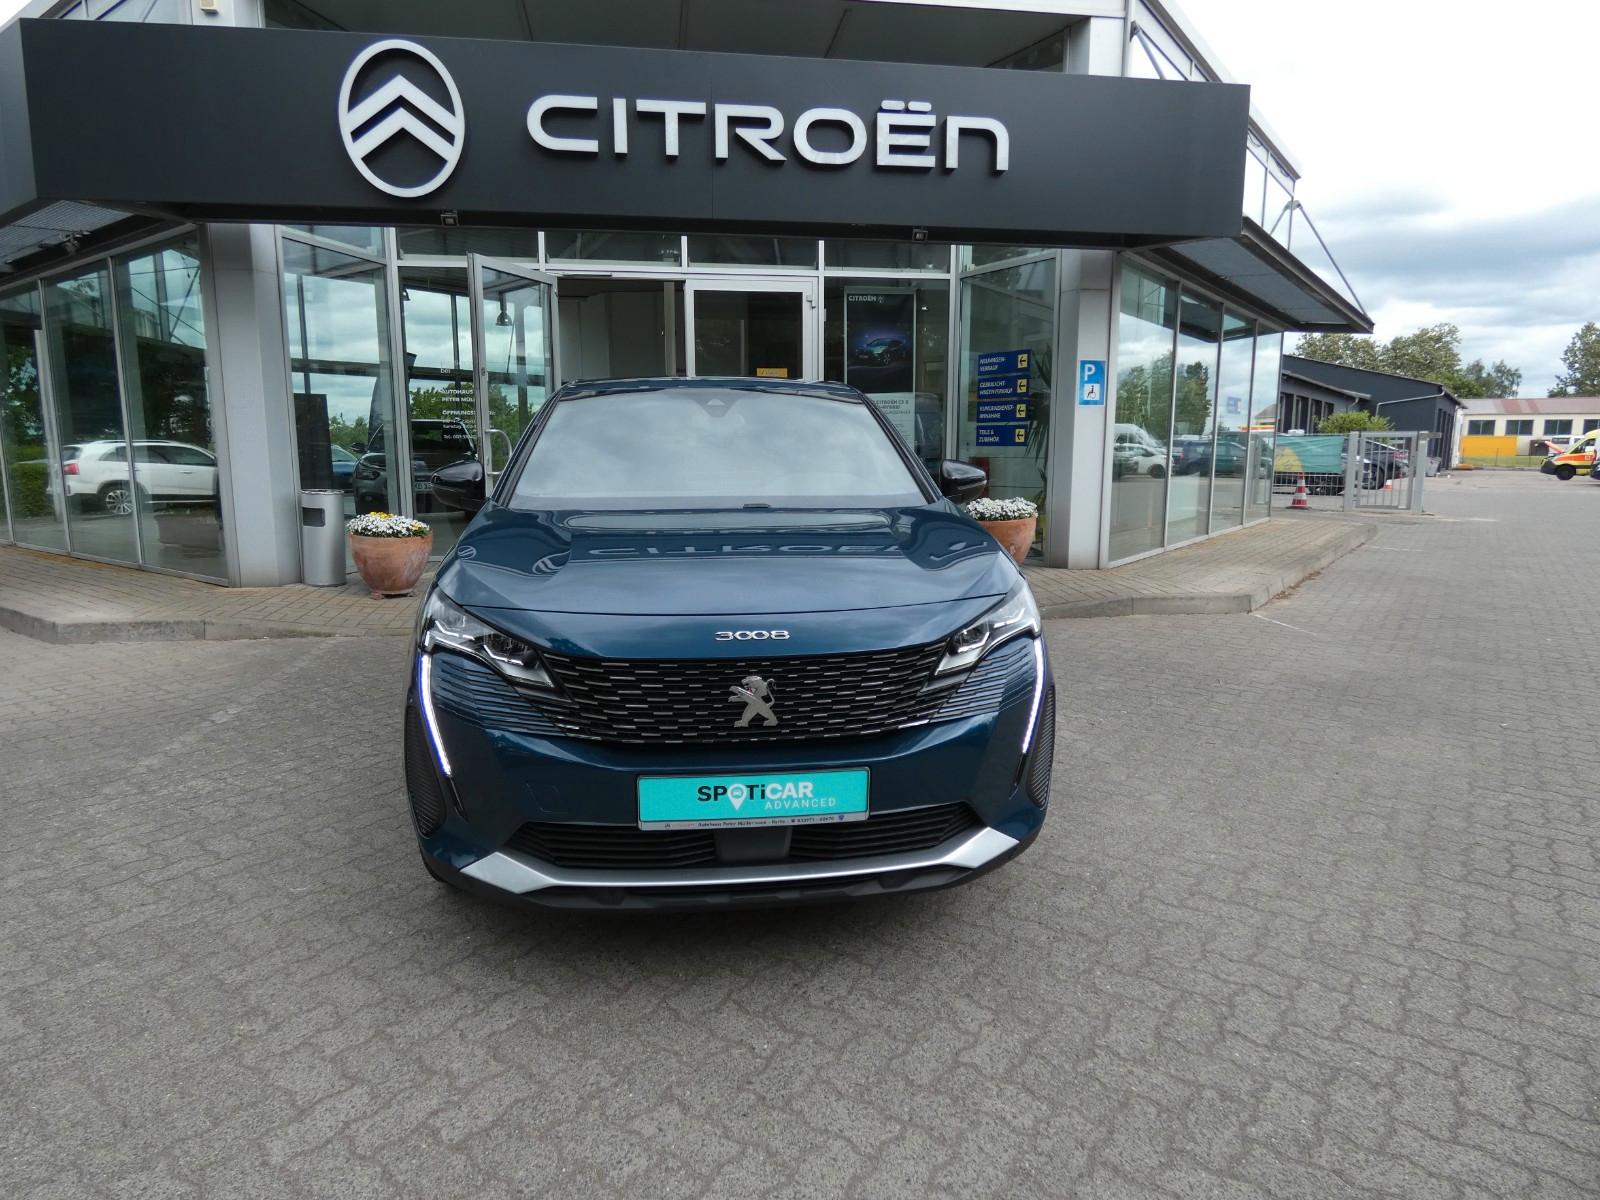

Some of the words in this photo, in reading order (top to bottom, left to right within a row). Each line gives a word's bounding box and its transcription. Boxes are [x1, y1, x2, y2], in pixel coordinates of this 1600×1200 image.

[526, 95, 1010, 172] CITROËN
[1084, 363, 1096, 381] P
[714, 630, 791, 641] 3008
[764, 797, 836, 810] ADVANCED
